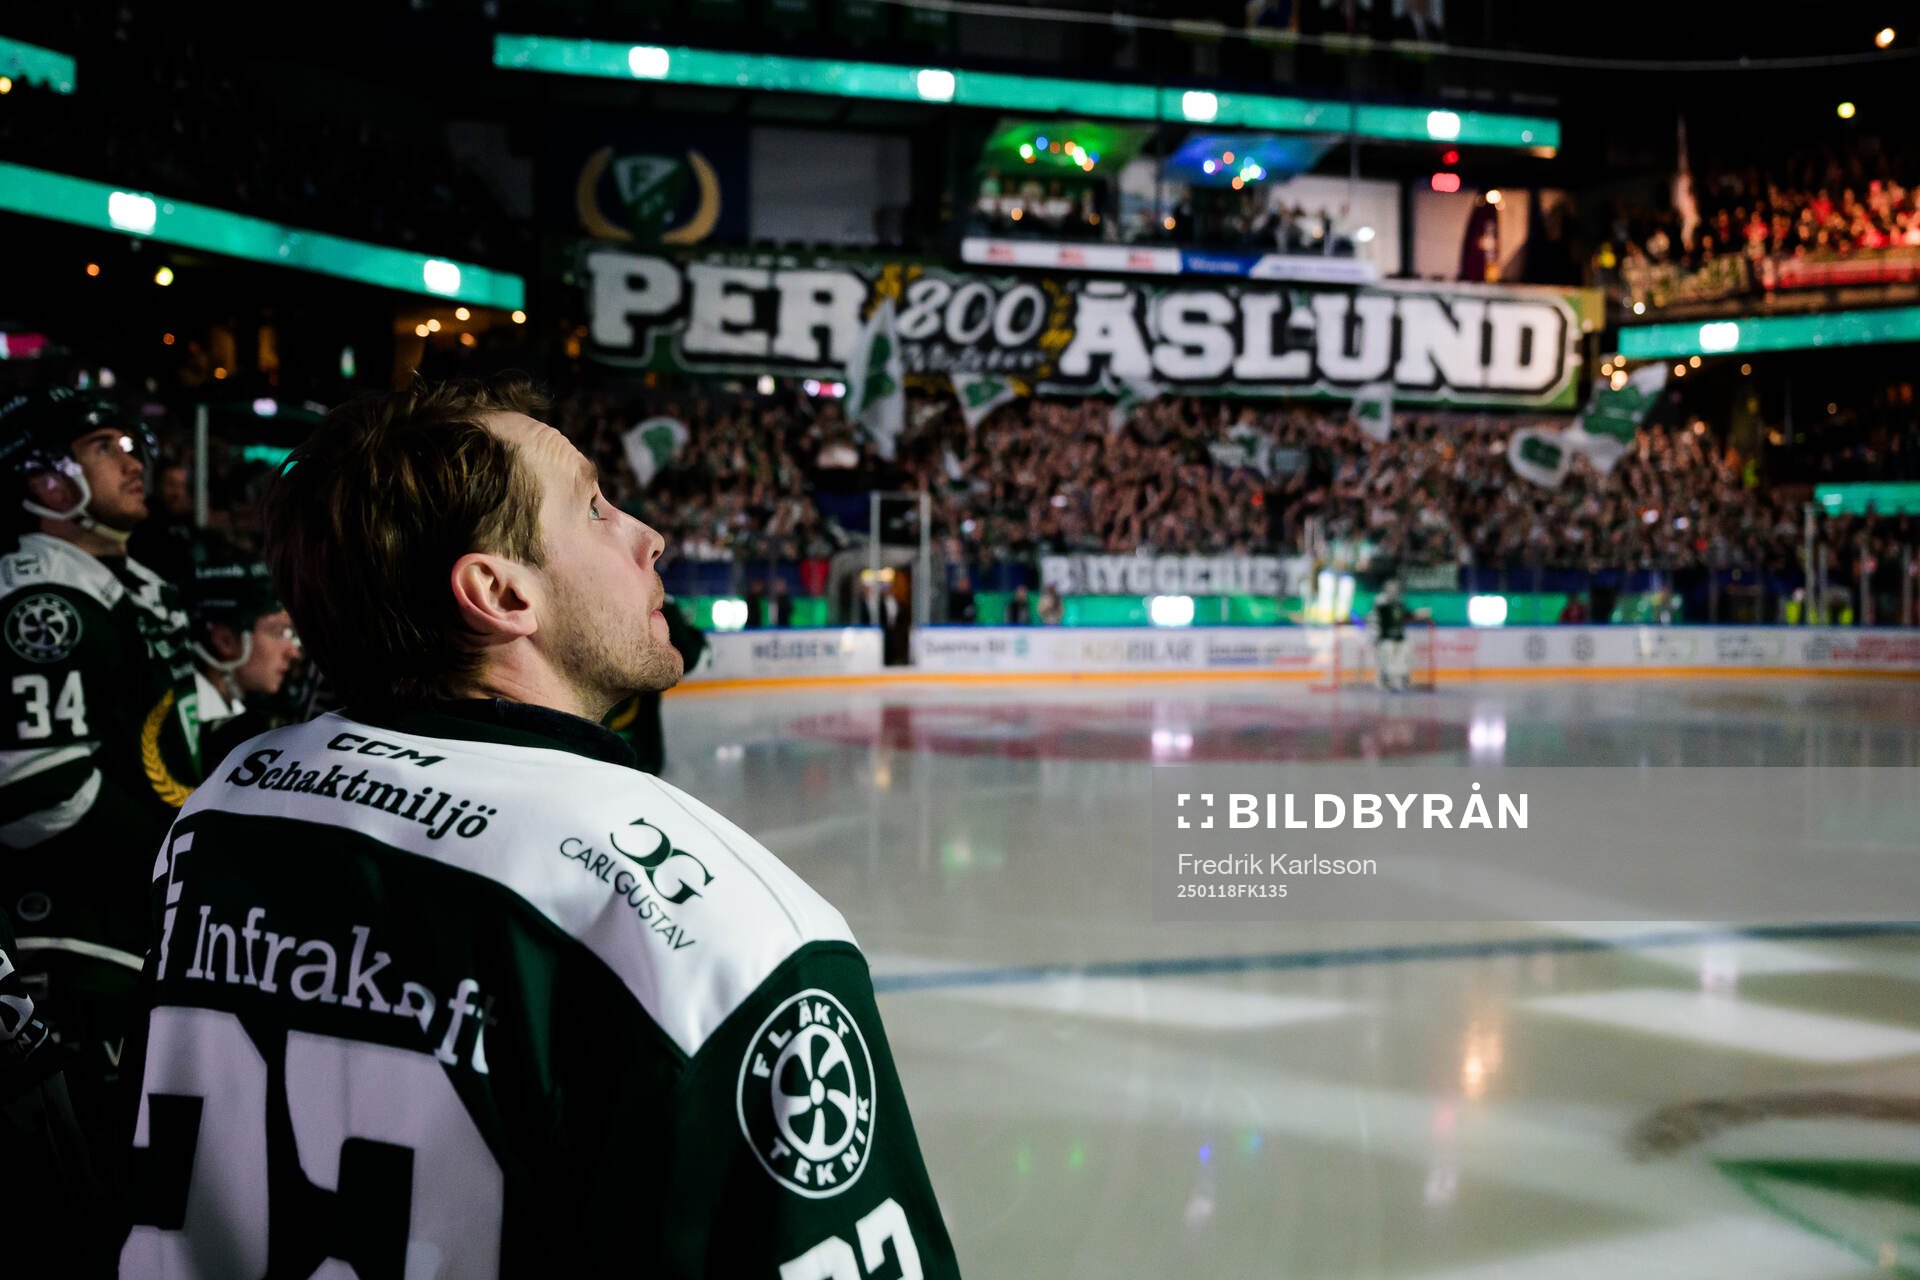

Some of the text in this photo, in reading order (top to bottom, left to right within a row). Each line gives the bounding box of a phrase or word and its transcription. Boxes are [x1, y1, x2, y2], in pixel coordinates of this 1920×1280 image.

[587, 251, 1565, 390] PER 800 ÅSLUND
[12, 671, 88, 740] 34
[326, 732, 448, 768] CCM
[225, 748, 498, 840] Schaktmiljö
[752, 999, 850, 1079] FLÄKT
[769, 1096, 870, 1186] TEKNIK
